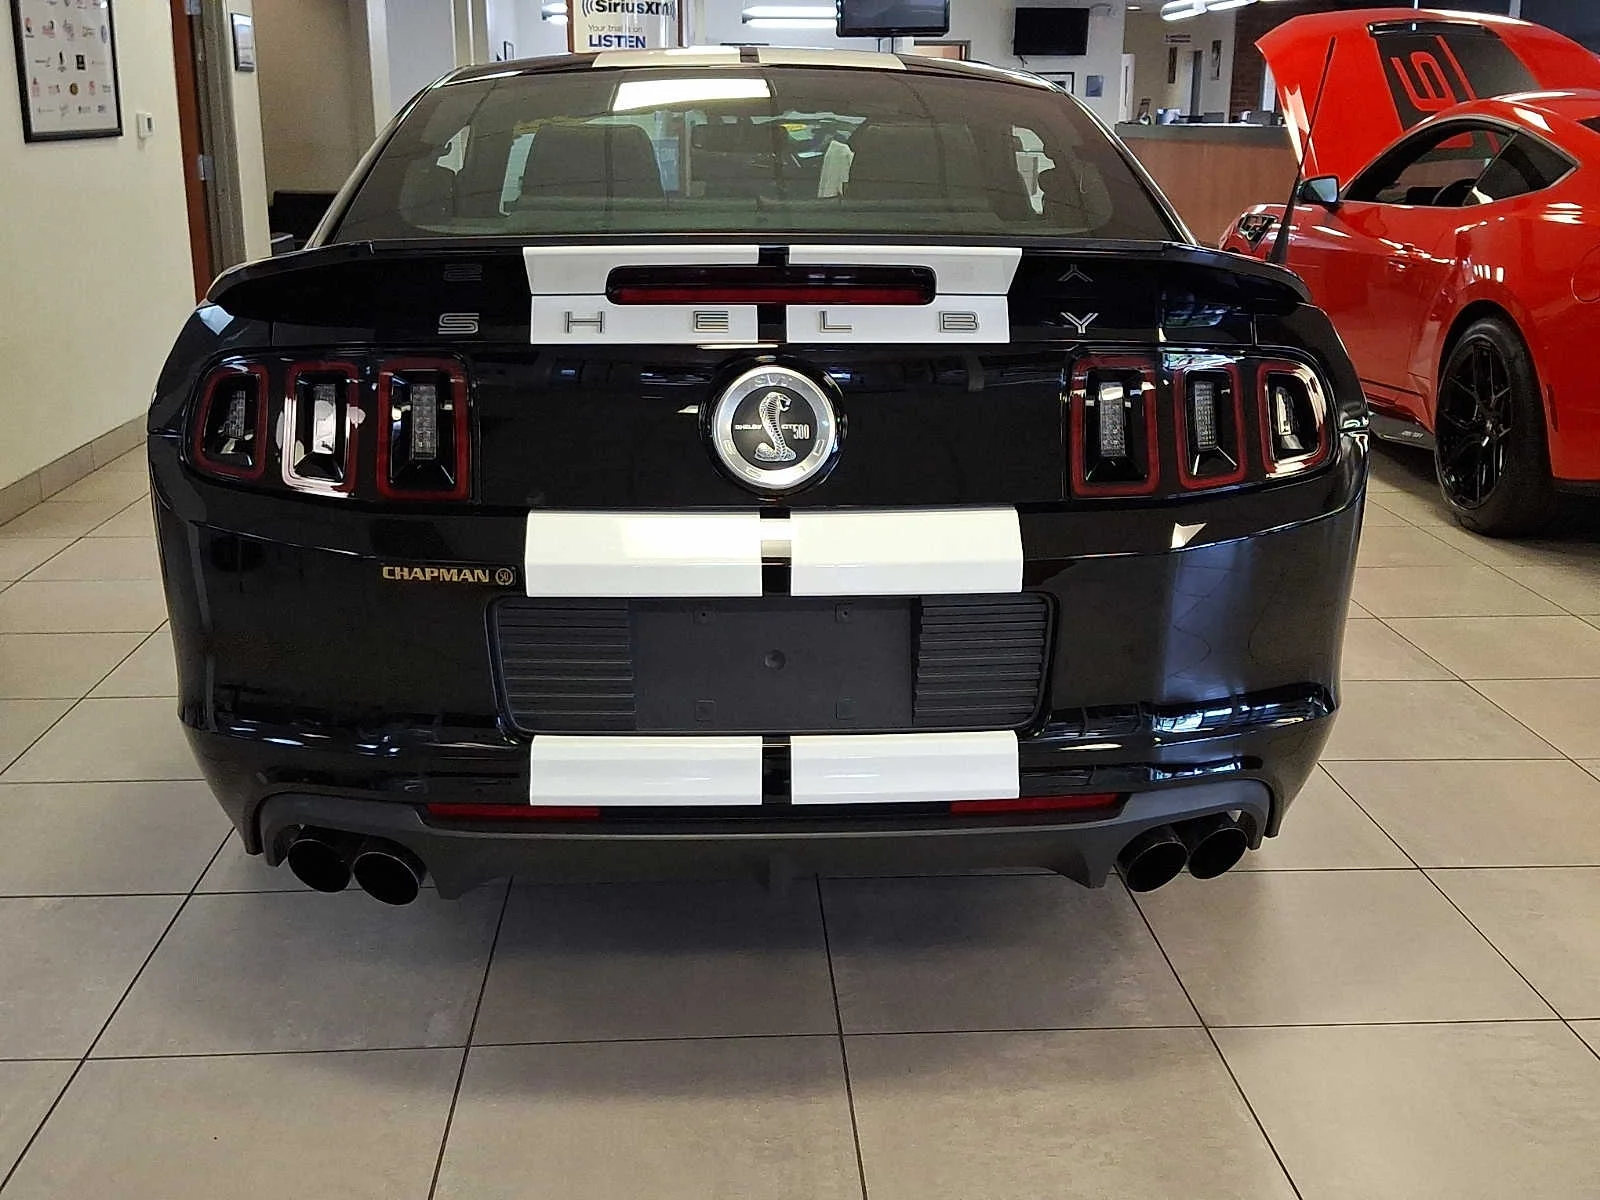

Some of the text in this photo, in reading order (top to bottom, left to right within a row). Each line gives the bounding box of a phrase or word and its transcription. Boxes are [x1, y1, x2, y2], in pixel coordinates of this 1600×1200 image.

[588, 24, 605, 32] Your
[589, 34, 646, 48] LISTEN
[438, 310, 1099, 335] SHELBY
[382, 566, 489, 583] CHAPMAN
